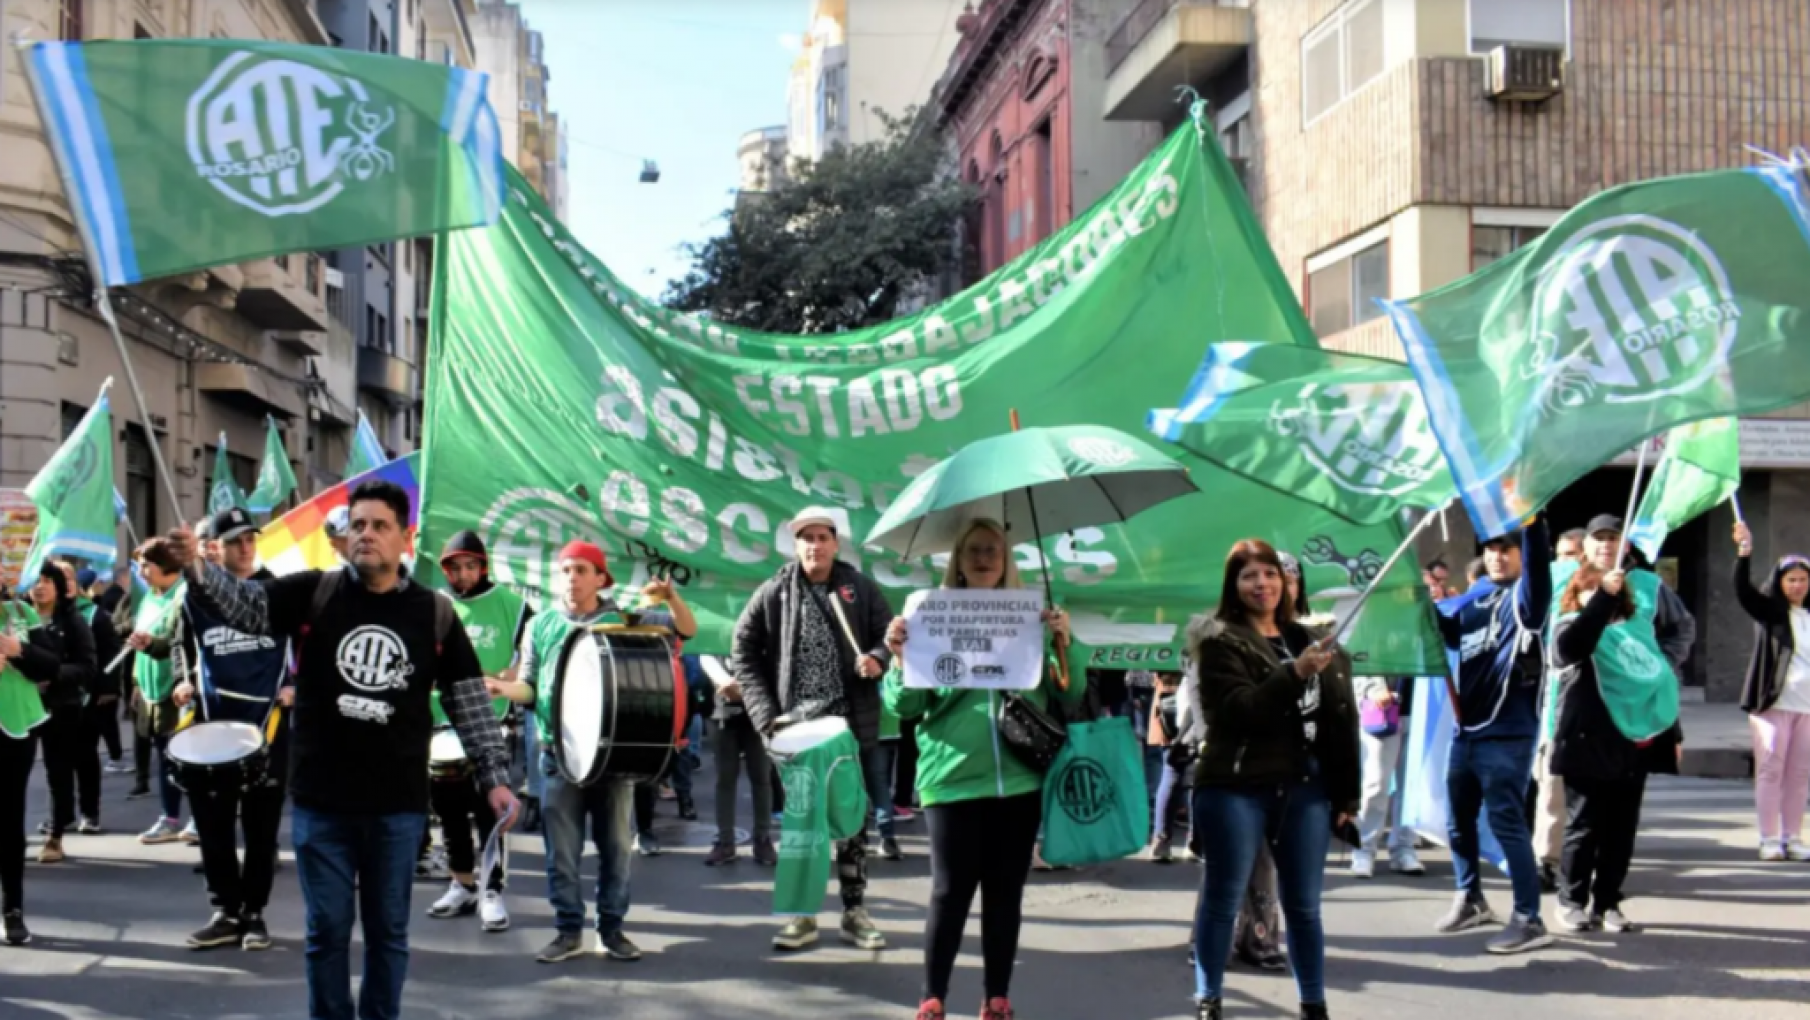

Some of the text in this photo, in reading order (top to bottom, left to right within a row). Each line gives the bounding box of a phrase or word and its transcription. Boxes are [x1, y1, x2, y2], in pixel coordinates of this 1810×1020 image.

[206, 59, 351, 199] ATE
[197, 148, 300, 178] ROSARIO
[732, 364, 964, 440] ESTADO
[921, 614, 945, 625] POR
[951, 600, 1039, 612] PROVINCIAL
[928, 628, 1019, 637] DE PARITARIAS
[344, 631, 401, 685] ATE
